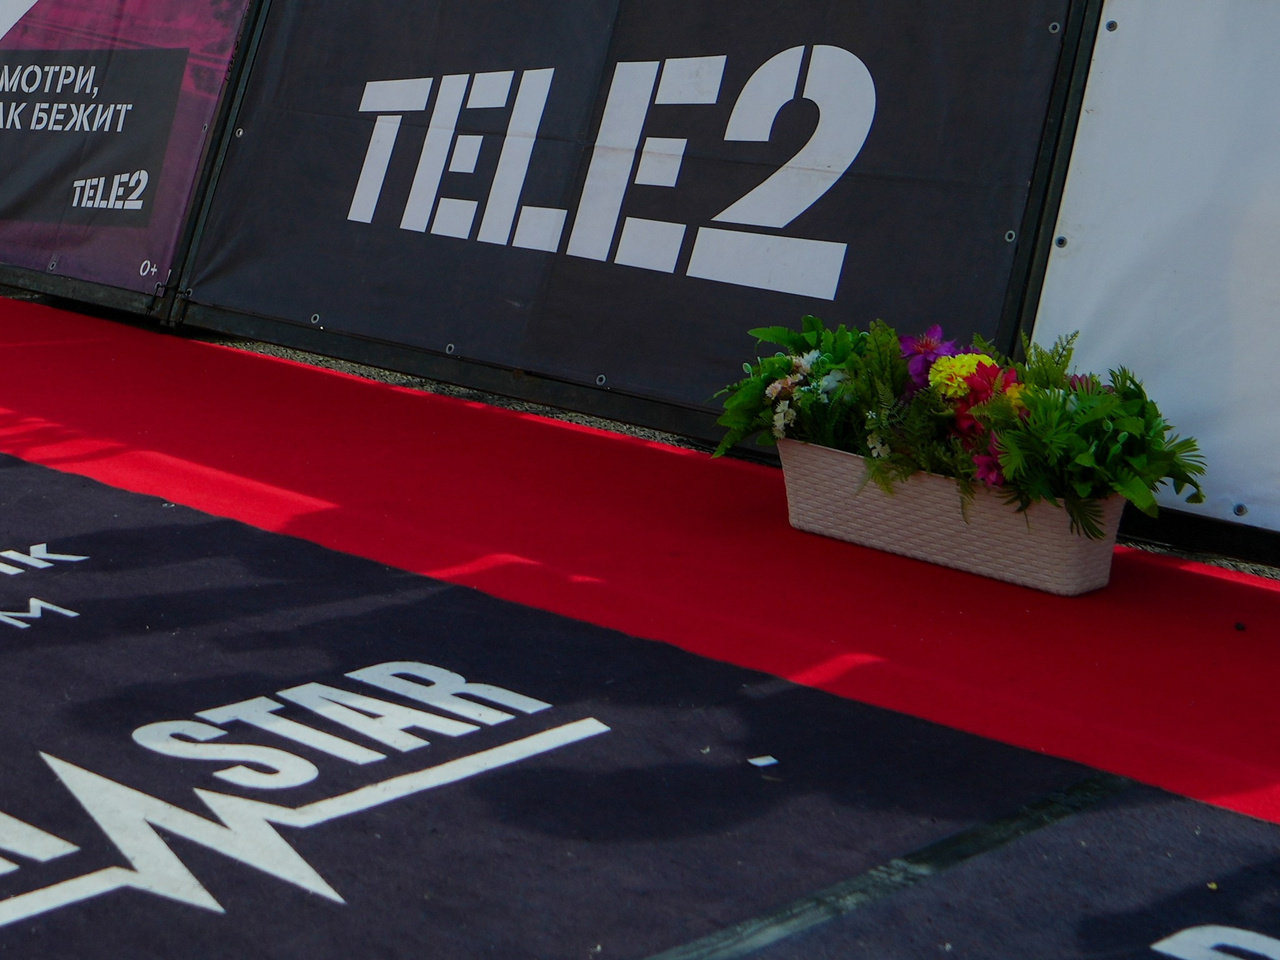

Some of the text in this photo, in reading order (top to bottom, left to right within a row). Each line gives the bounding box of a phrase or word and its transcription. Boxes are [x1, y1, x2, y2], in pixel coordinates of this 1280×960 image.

[30, 102, 133, 133] БЕЖИТ
[72, 169, 149, 210] TELE2
[346, 44, 877, 301] TELE2
[139, 259, 158, 277] 0+
[131, 660, 554, 790] STAR
